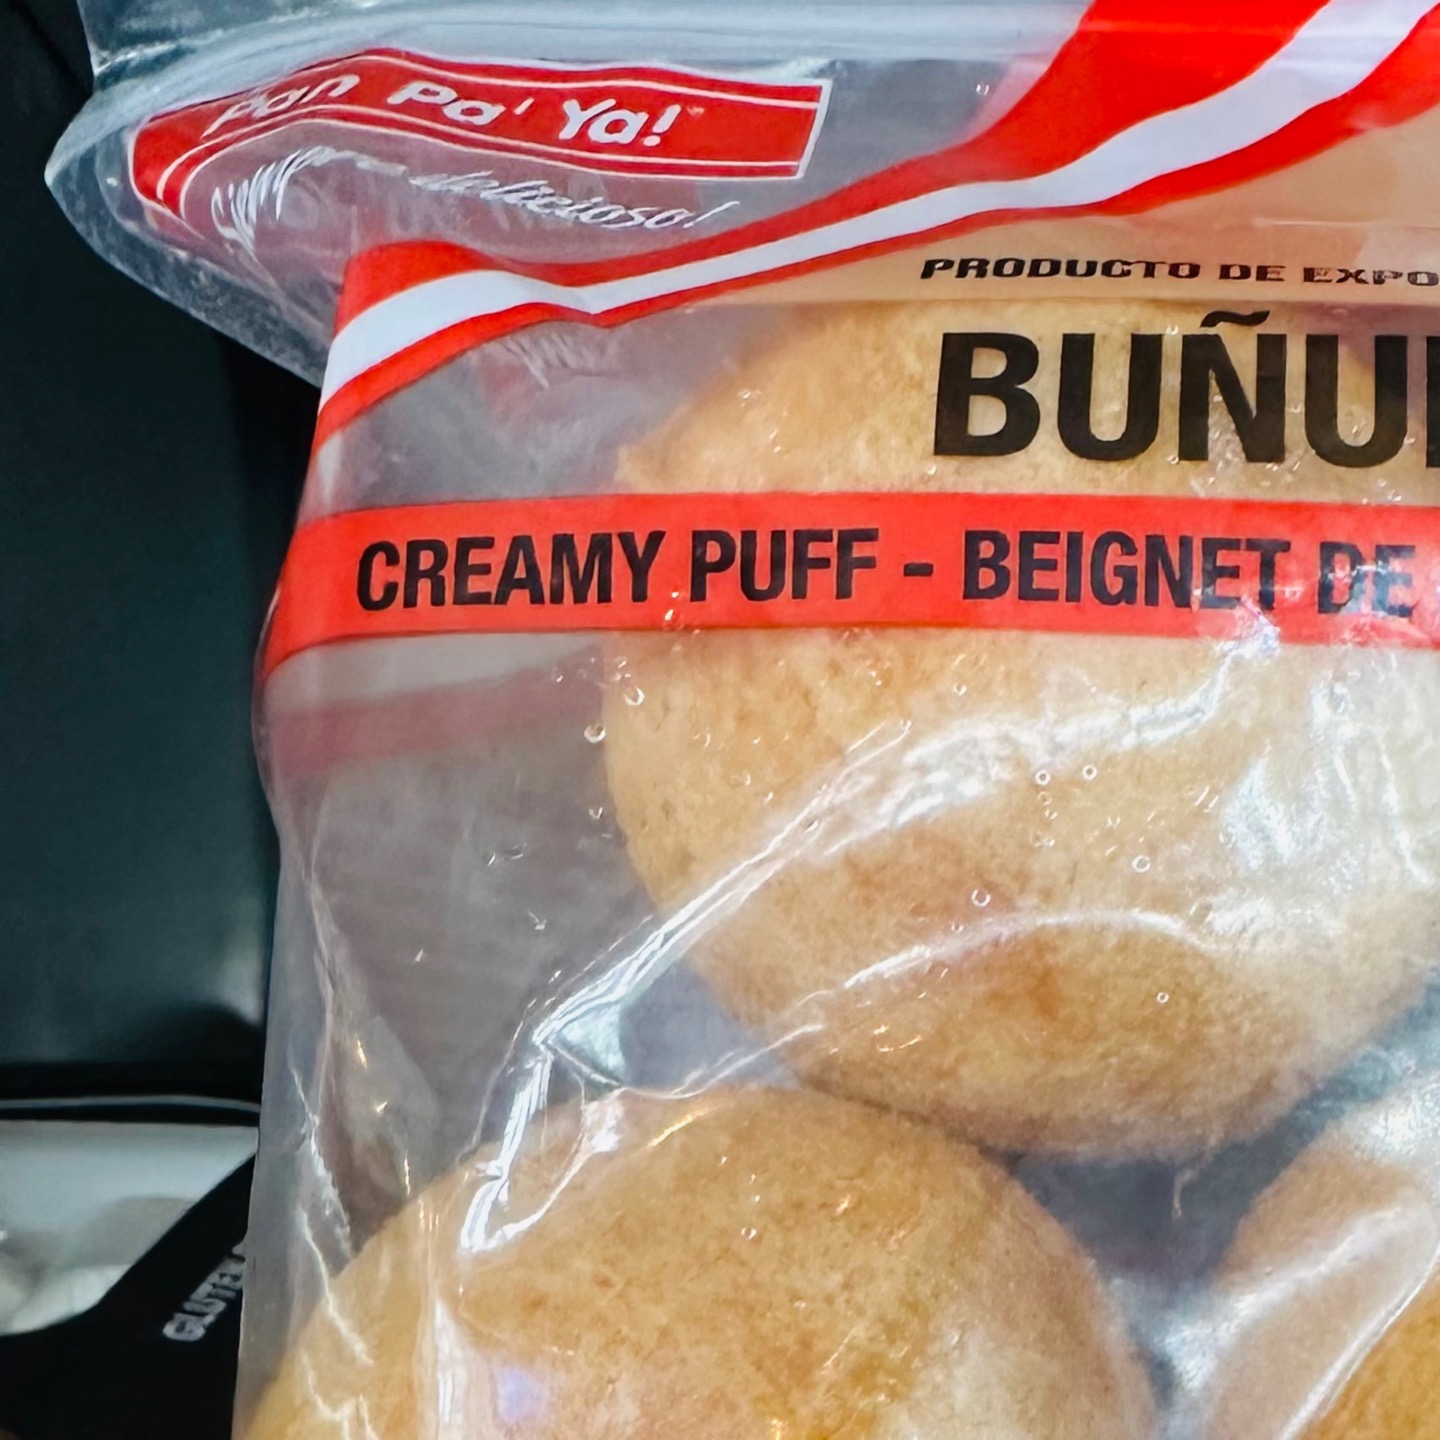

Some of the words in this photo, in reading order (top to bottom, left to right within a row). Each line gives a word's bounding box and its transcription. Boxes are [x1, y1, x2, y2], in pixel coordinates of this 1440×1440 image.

[387, 80, 534, 126] Pa'
[560, 97, 682, 148] Ya!
[920, 257, 1201, 281] PRODUCTO
[1219, 263, 1285, 283] DE
[357, 529, 665, 612] CREAMY
[690, 526, 878, 602] PUFF
[961, 529, 1291, 610] BEIGNET
[1318, 541, 1416, 619] DE
